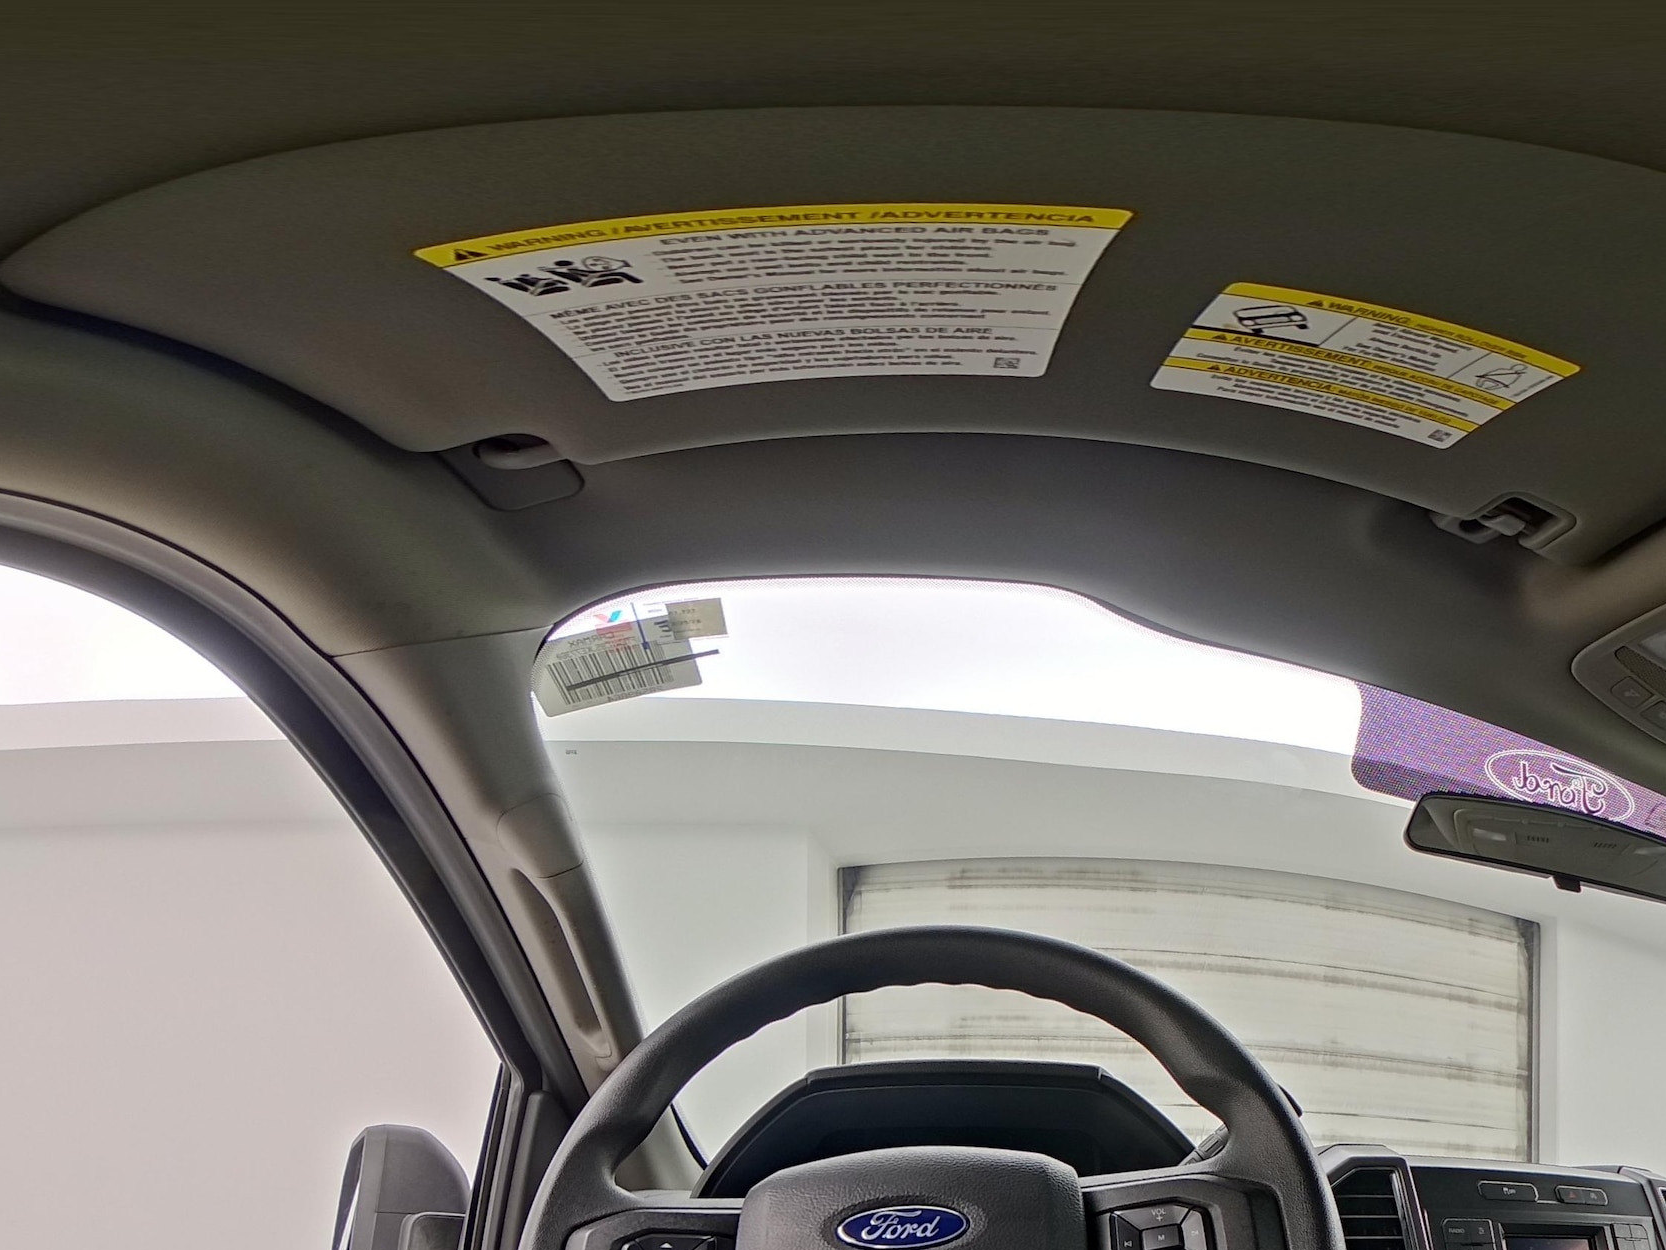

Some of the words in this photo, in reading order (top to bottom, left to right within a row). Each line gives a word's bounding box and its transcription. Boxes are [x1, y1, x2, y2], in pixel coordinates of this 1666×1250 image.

[487, 229, 607, 251] WARNING
[660, 234, 723, 245] EVEN
[728, 231, 787, 240] WITH
[794, 227, 927, 236] ADVANCED
[983, 227, 1050, 237] BAGS
[605, 299, 651, 311] AVEC
[656, 293, 693, 305] DES
[696, 288, 749, 299] SACS
[753, 281, 888, 294] GONFLABLES
[893, 281, 1057, 292] PERFECTIONNÉS
[613, 341, 696, 358] INCLUSIVE
[700, 337, 736, 345] CON
[740, 333, 773, 342] LAS
[776, 328, 846, 339] NUEVAS
[850, 327, 921, 335] BOLSAS
[1151, 1208, 1166, 1216] VOL
[861, 1210, 941, 1241] Ford
